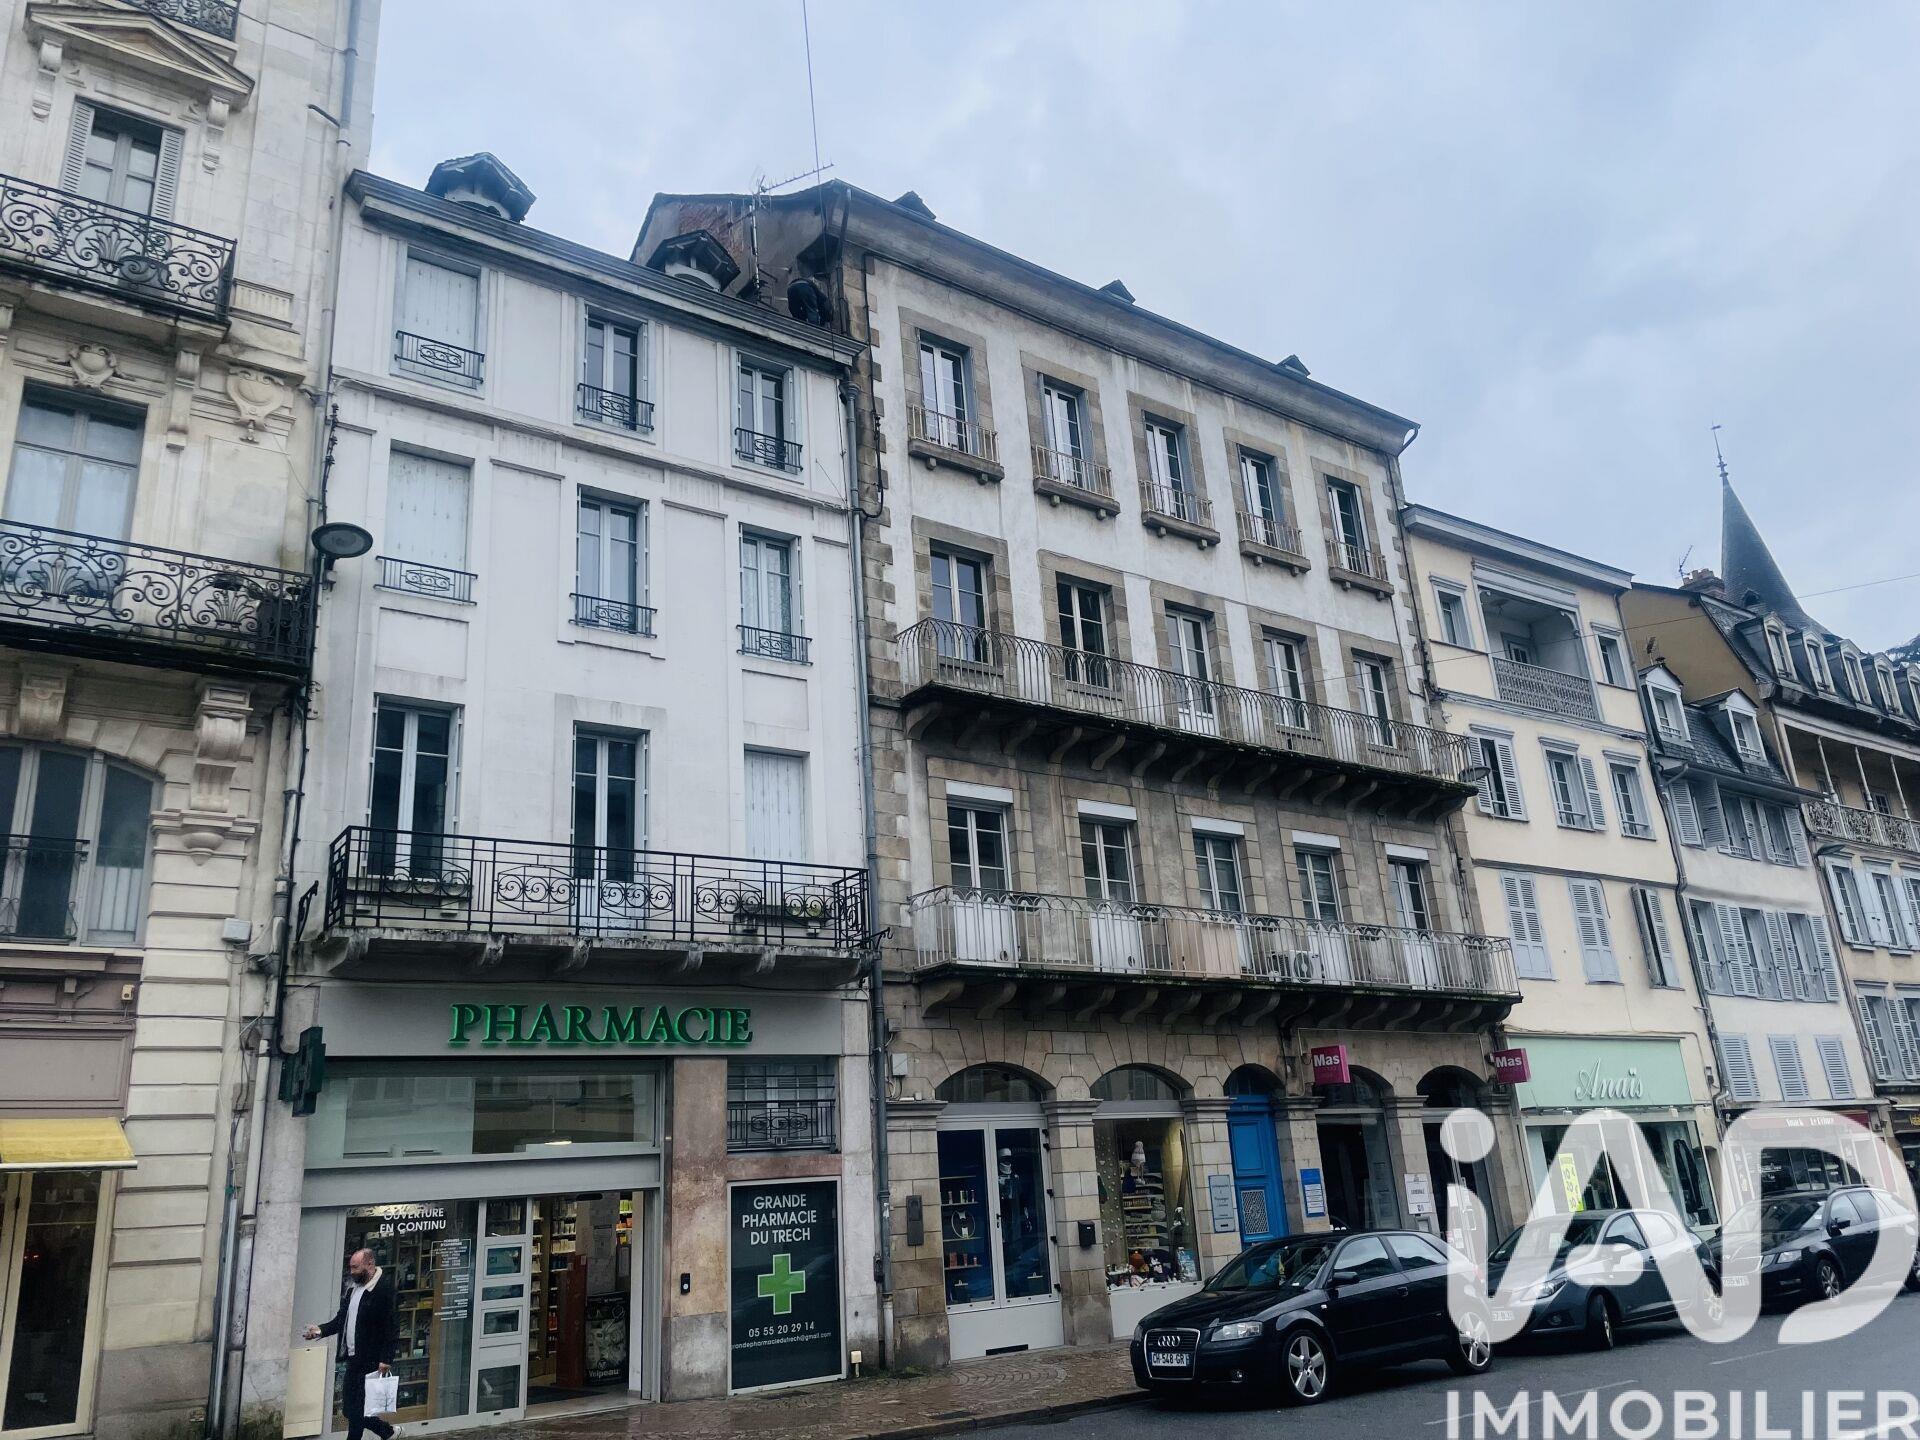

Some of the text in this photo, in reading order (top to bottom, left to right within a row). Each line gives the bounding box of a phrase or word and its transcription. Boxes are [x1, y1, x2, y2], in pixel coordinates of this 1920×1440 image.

[449, 1002, 753, 1046] PHARMACIE
[1313, 1054, 1340, 1067] Mas
[1495, 1056, 1522, 1068] Mas
[1575, 1056, 1643, 1101] Anaïs
[753, 1194, 807, 1210] GRANDE
[384, 1207, 445, 1221] OUVERTURE
[742, 1210, 817, 1228] PHARMACIE
[379, 1220, 447, 1233] EN CONTINU
[750, 1227, 811, 1246] DU TRECH
[748, 1321, 815, 1337] 05 55 20 29 14
